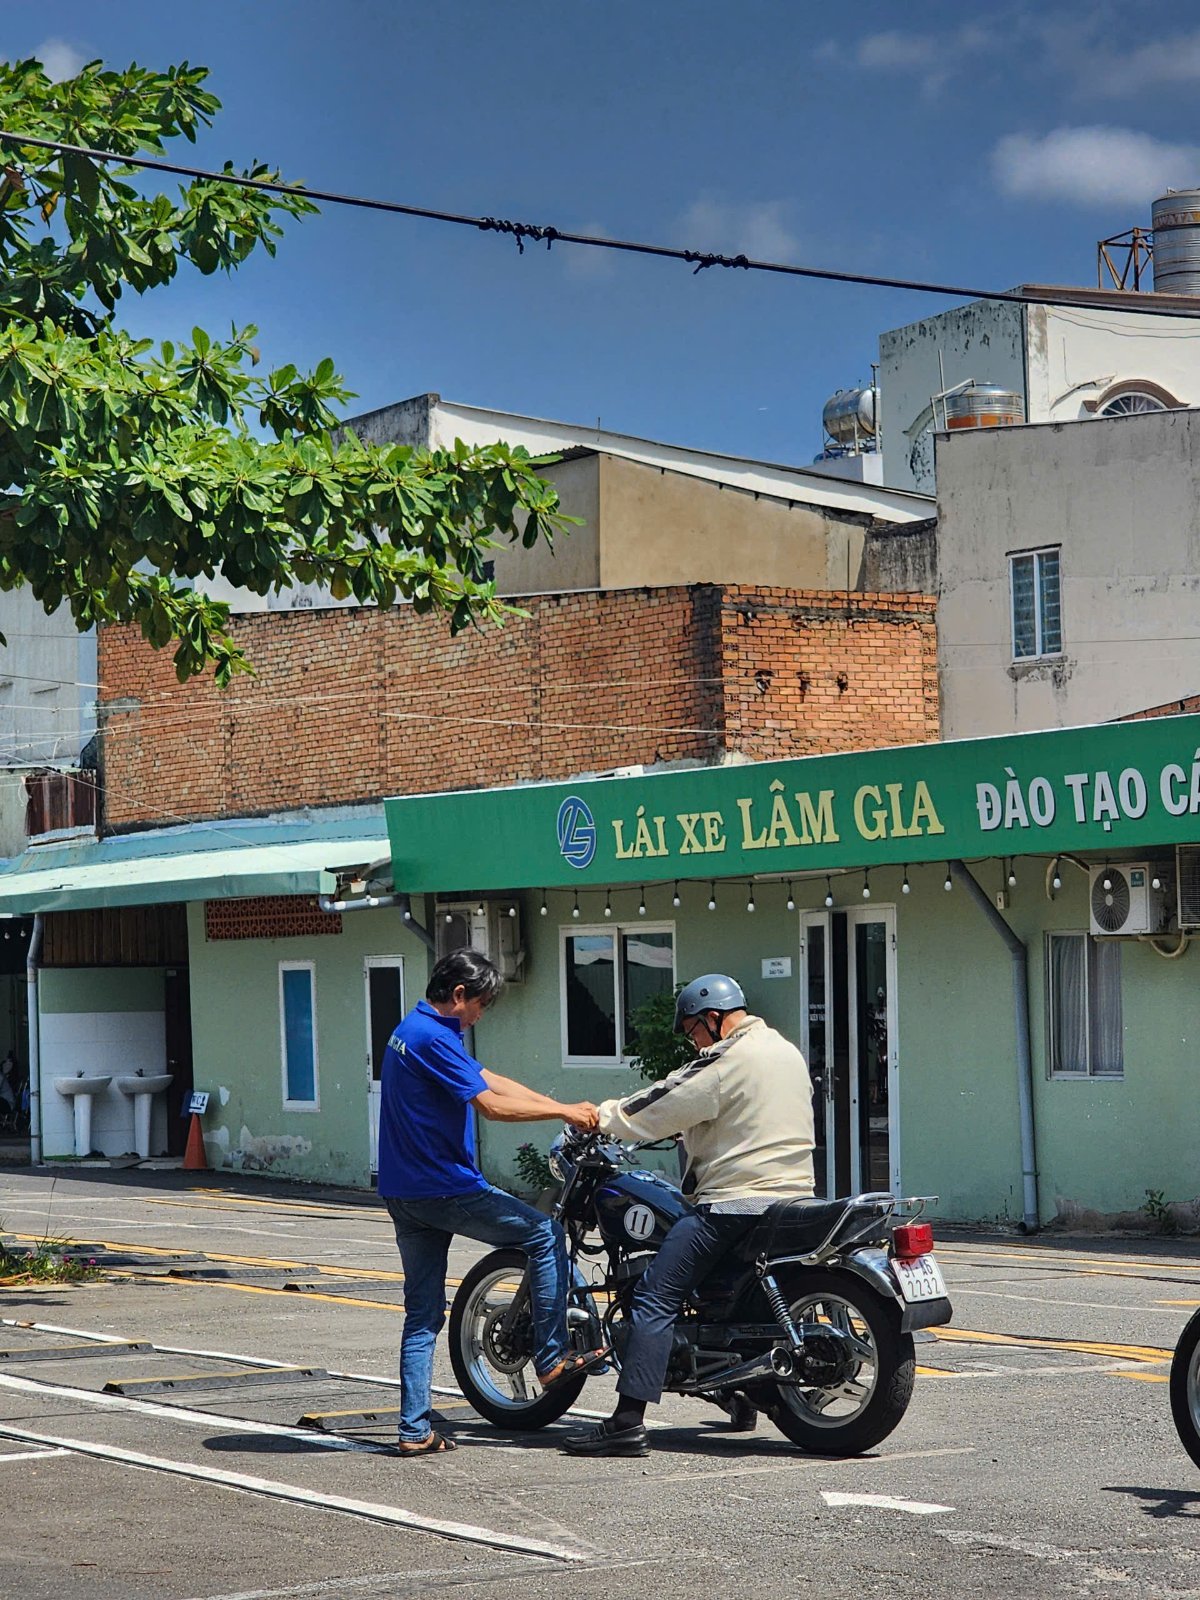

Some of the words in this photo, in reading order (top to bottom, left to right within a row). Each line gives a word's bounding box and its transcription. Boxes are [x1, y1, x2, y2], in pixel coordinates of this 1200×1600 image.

[612, 805, 669, 859] LÁI
[677, 811, 726, 854] XE
[737, 778, 840, 849] LÂM
[854, 780, 945, 841] GIA
[976, 767, 1055, 830] ĐÀO
[1064, 768, 1147, 831] TẠO
[630, 1210, 649, 1236] 11
[908, 1277, 941, 1298] 2232
